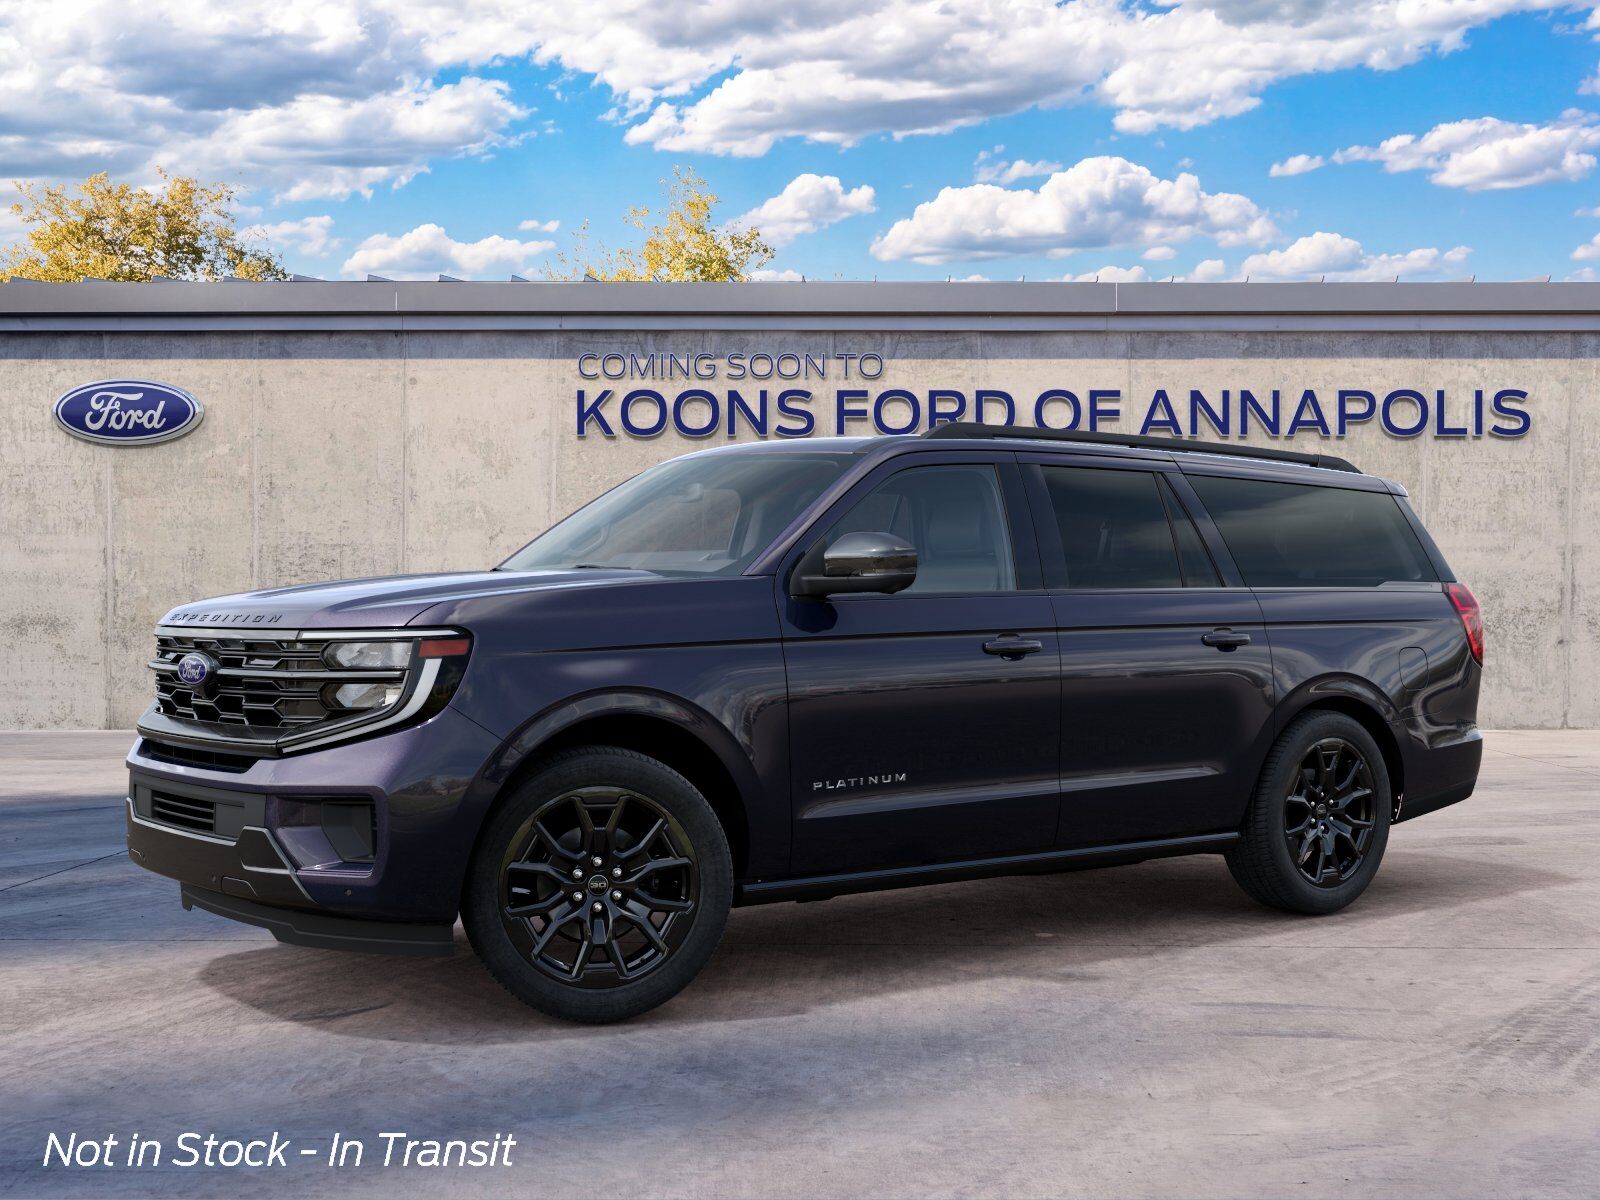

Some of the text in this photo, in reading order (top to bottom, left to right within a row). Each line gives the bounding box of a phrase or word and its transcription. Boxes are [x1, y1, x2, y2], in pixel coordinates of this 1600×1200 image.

[577, 352, 884, 380] COMING SOON TO
[84, 391, 167, 431] Ford
[576, 389, 1533, 438] KOONS FORD OF ANNAPOLIS
[169, 613, 284, 624] EXPEDITION
[182, 659, 202, 680] Ford
[812, 773, 907, 791] PLATINUM
